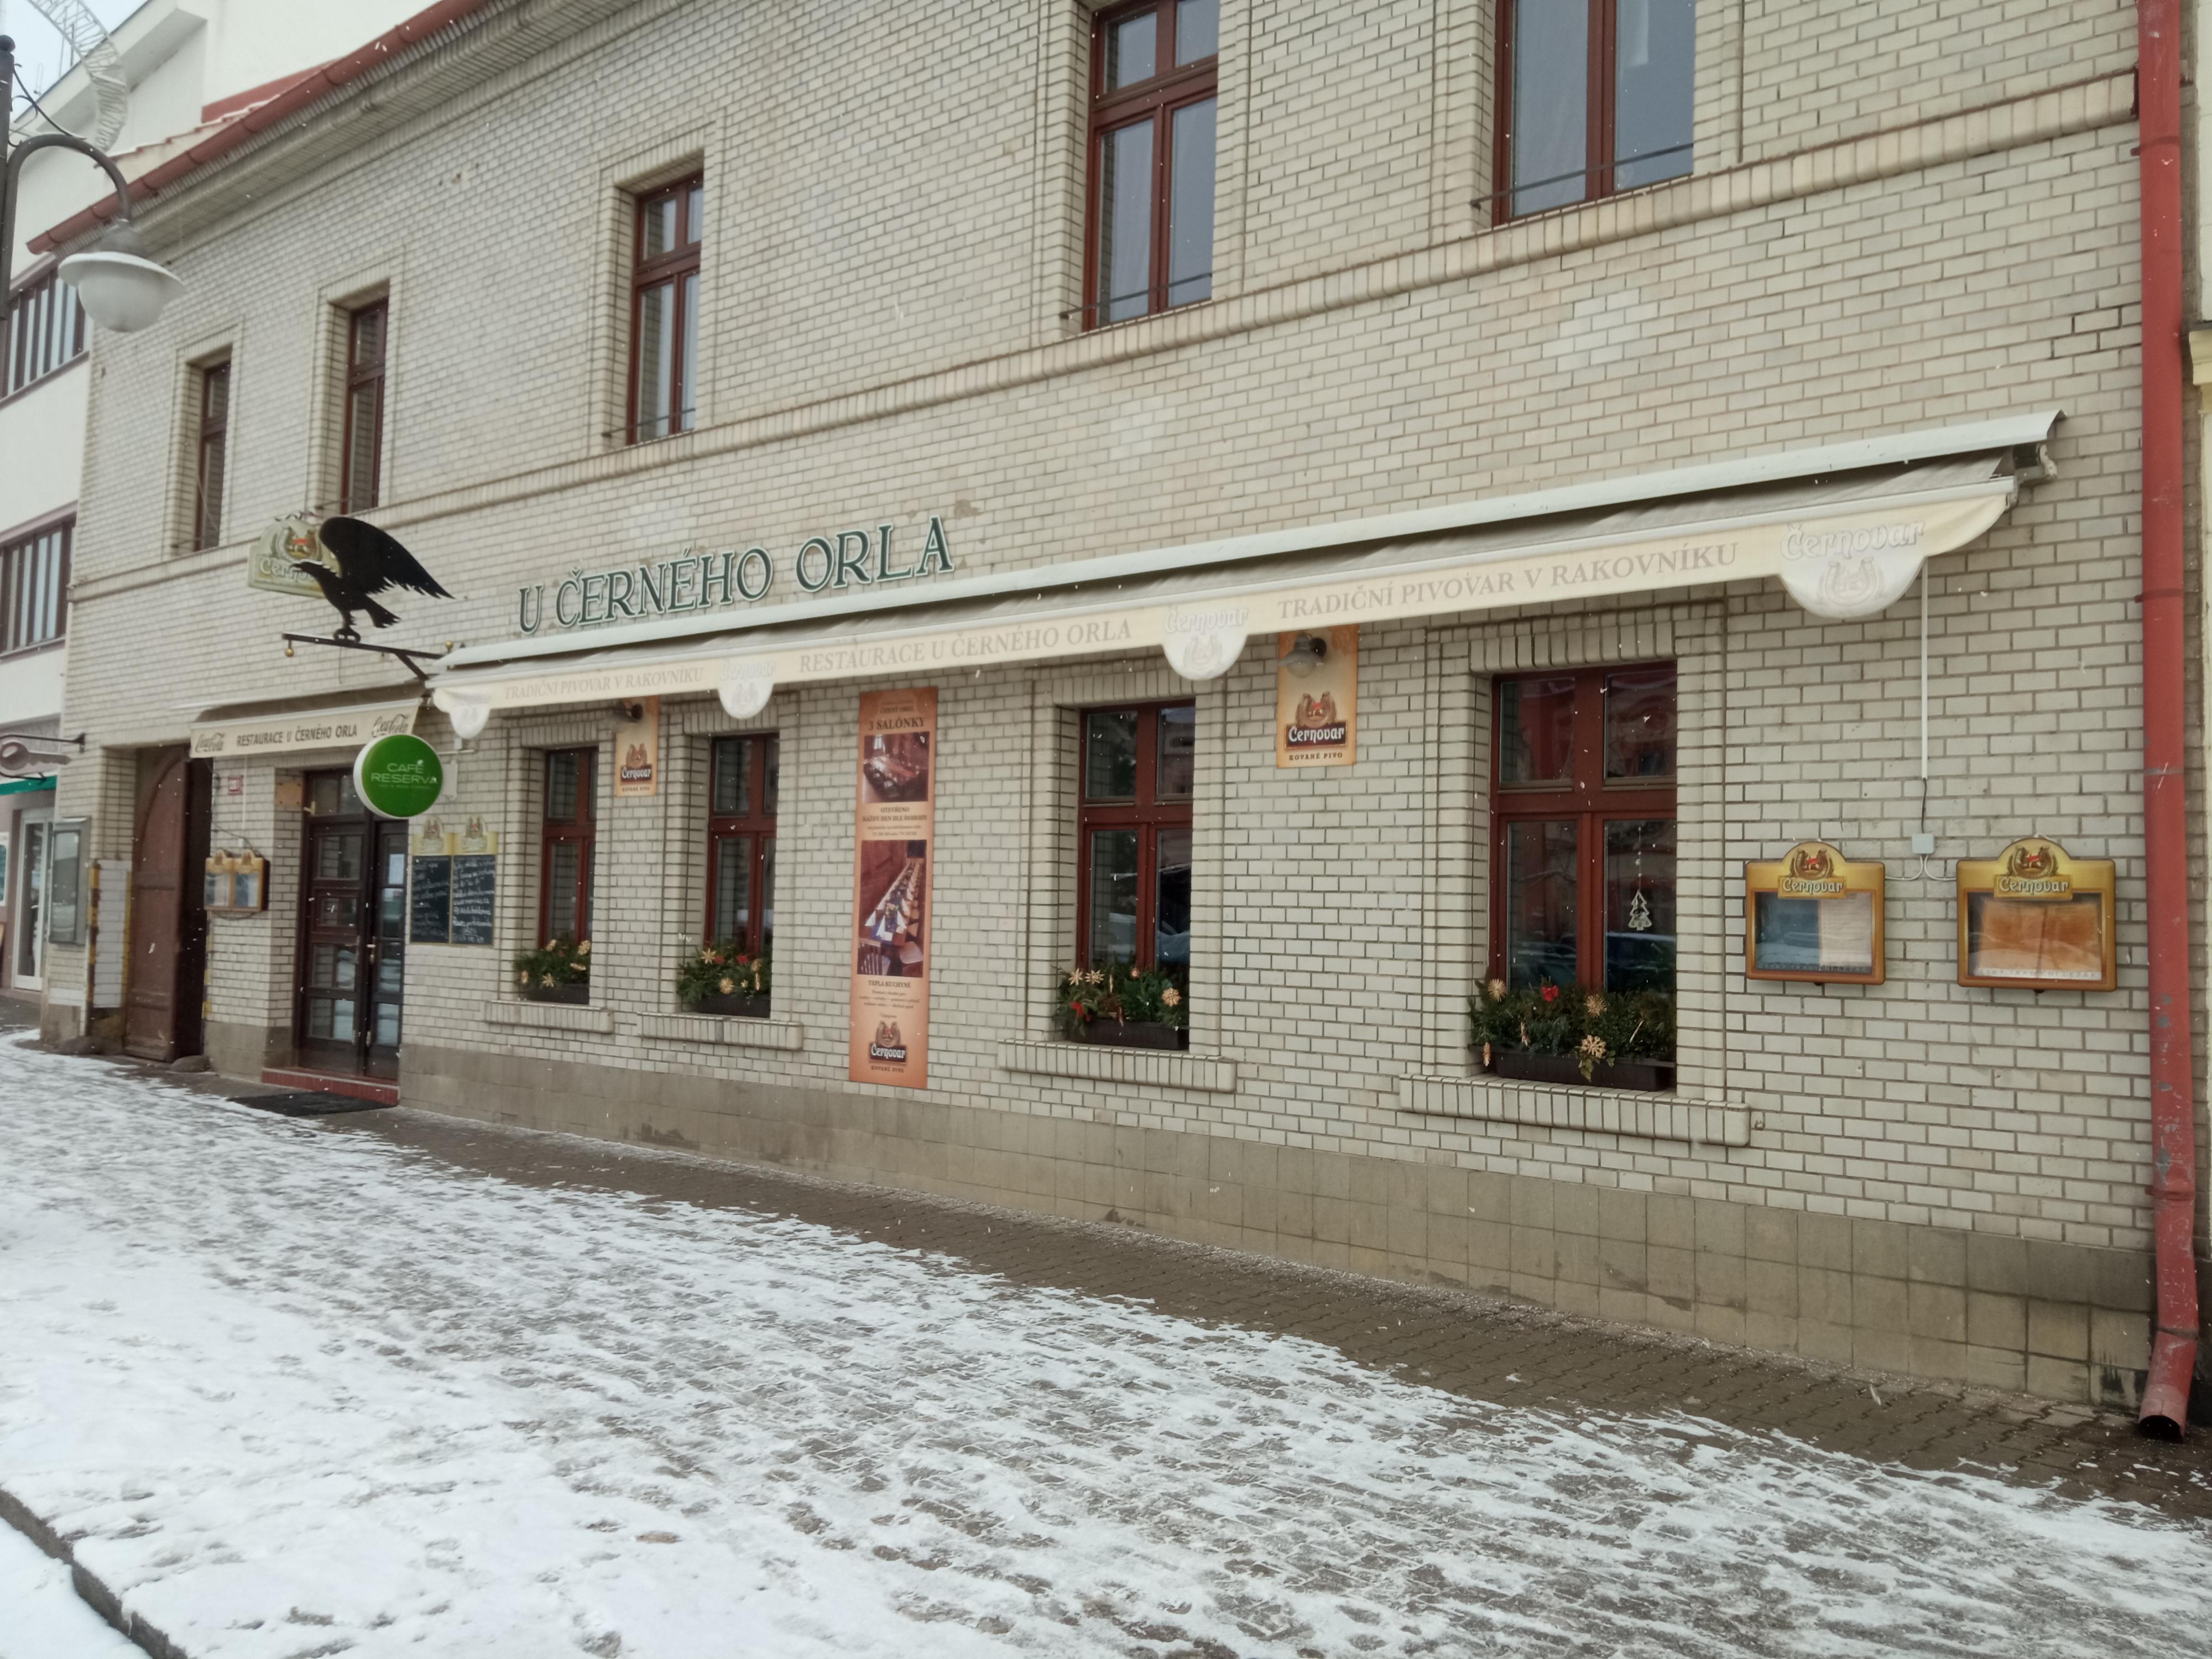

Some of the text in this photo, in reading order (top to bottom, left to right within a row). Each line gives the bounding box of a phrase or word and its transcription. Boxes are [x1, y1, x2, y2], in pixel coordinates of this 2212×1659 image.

[1781, 519, 1925, 561] Černovar
[519, 514, 954, 635] U ČERNÉHO ORLA
[1277, 542, 1738, 619] TRADIČNÍ PIVOVAR V RAKOVNÍKU
[1164, 605, 1248, 634] Černovar
[799, 618, 1131, 674] RESTAURACE U ČERNÉHO ORLA
[504, 678, 559, 700] TRADIČNÍ
[561, 676, 612, 695] PIVOVAR
[614, 675, 624, 689] V
[625, 666, 704, 689] RAKOVNÍKU
[236, 723, 357, 747] RESTAURACE U ČERNÉHO ORLA
[868, 716, 925, 731] 3 SALÓNKY
[1288, 726, 1345, 743] Černovar
[1288, 752, 1321, 761] KOVANÉ
[371, 773, 438, 784] RESERVA
